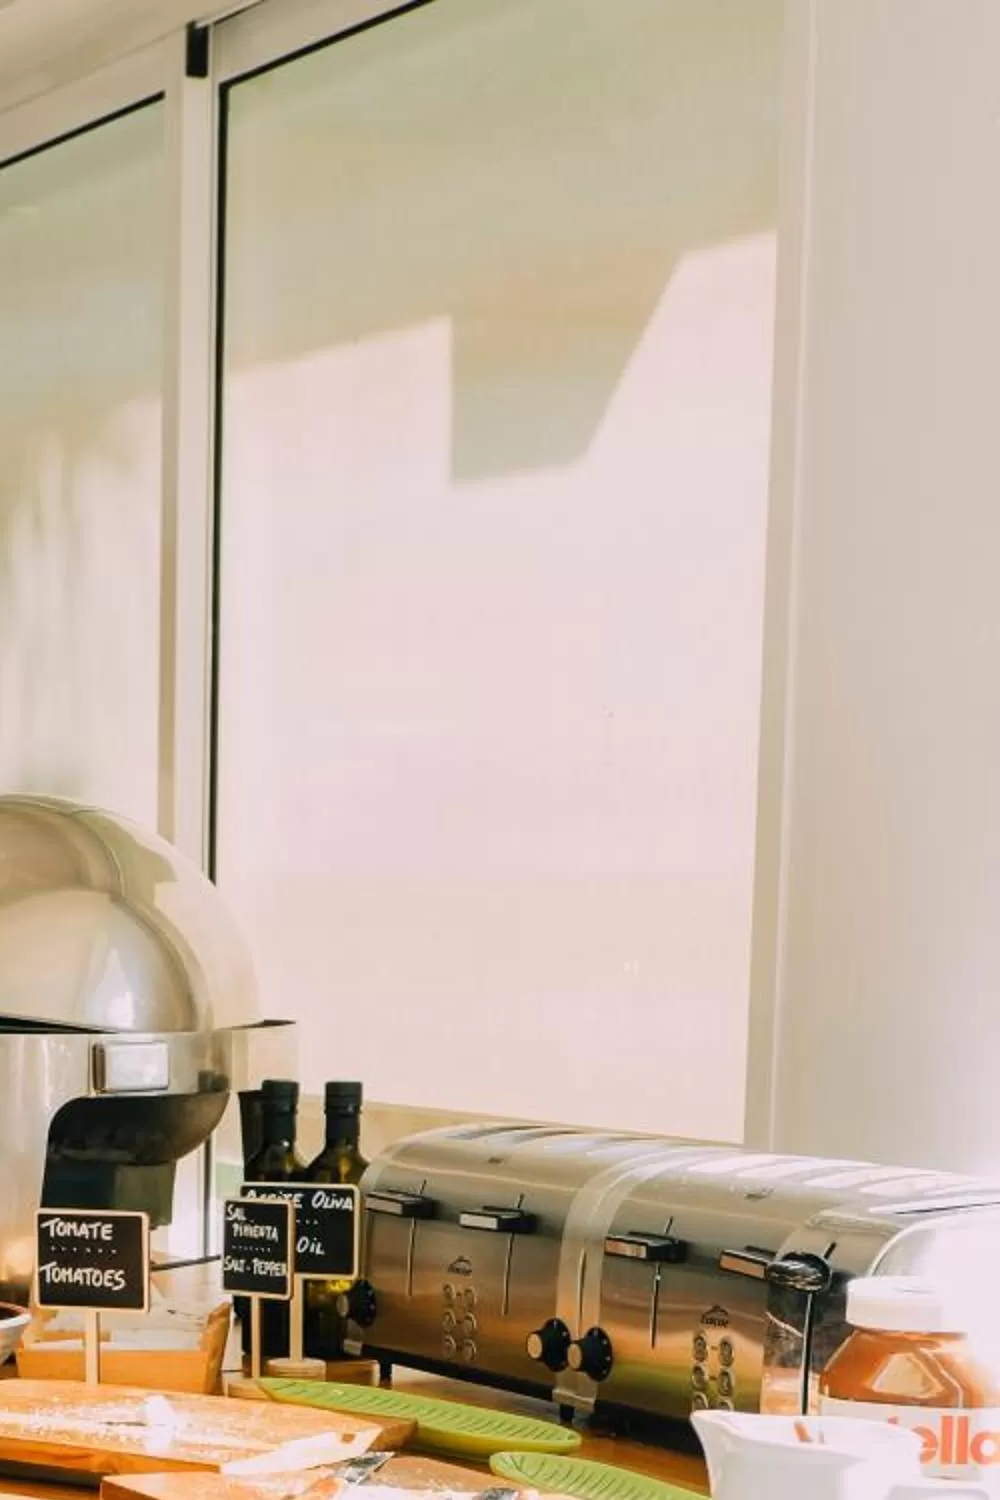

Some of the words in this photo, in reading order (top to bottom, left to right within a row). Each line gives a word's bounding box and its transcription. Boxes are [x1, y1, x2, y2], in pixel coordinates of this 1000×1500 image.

[40, 1217, 113, 1240] TOMATE
[40, 1261, 127, 1291] TOMATOES
[910, 1415, 1000, 1465] ella
